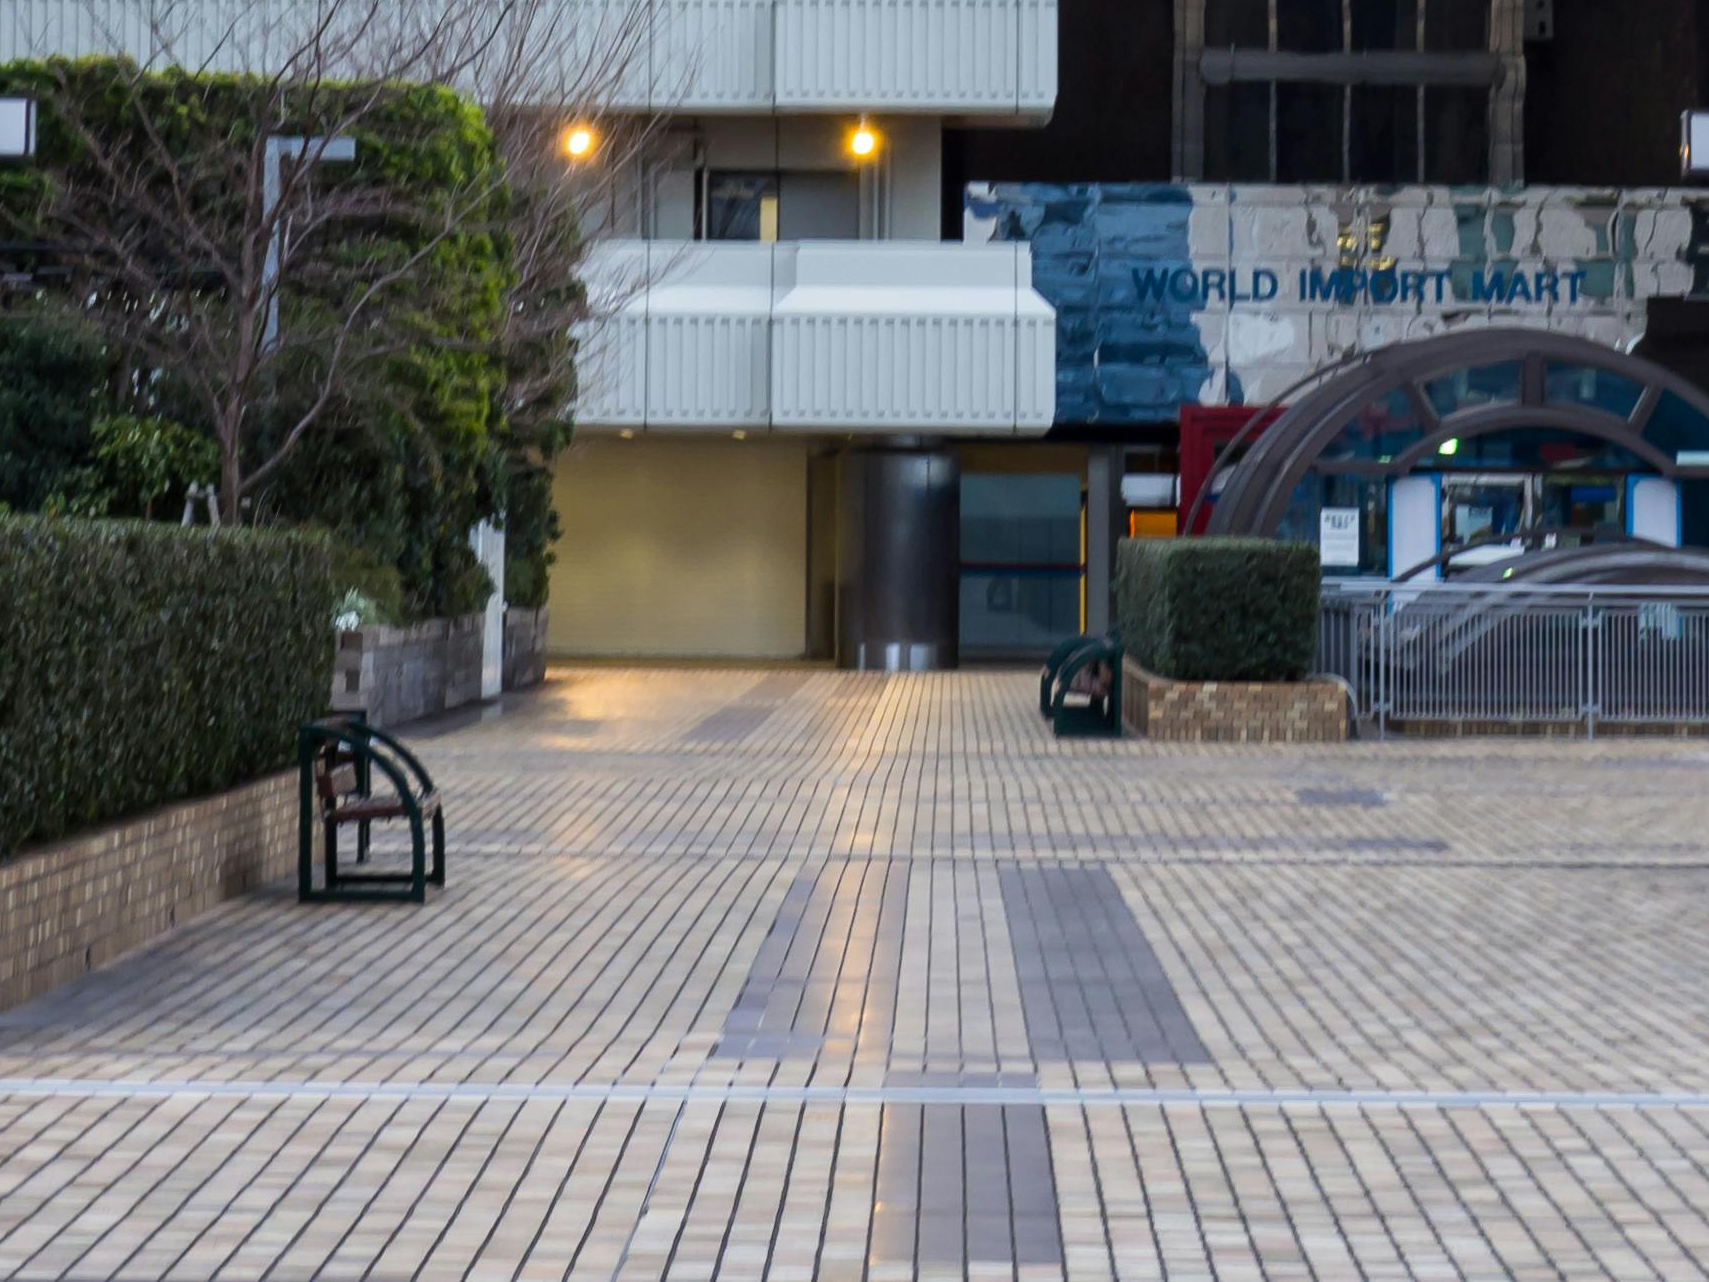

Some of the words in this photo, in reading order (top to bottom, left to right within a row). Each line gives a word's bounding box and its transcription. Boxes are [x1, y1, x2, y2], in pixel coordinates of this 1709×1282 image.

[1131, 267, 1279, 304] WORLD
[1298, 268, 1453, 305] IMPORT
[1470, 269, 1588, 304] MART
